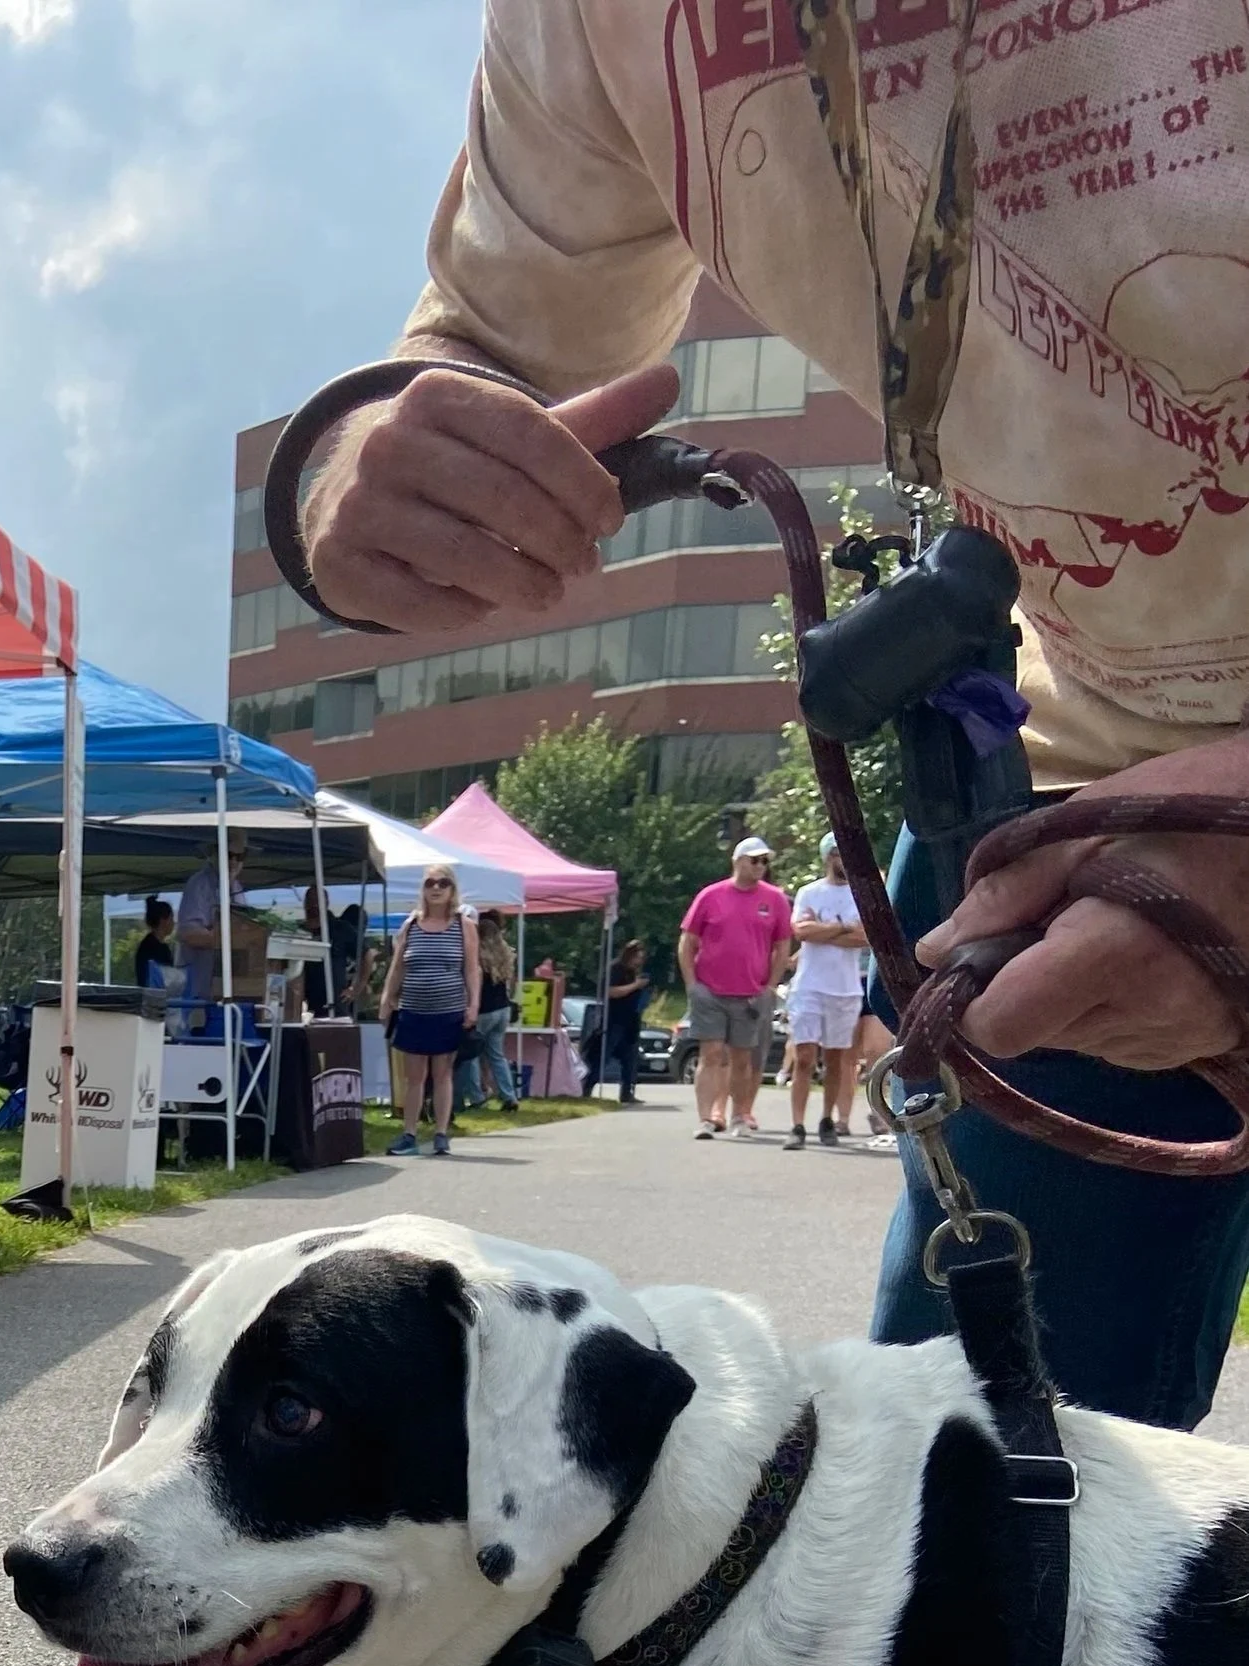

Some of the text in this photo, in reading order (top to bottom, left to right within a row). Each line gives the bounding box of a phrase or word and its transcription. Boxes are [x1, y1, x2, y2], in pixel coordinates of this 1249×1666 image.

[1190, 44, 1248, 84] THE
[972, 96, 1211, 191] UPERSHOW OF
[993, 184, 1048, 221] THE
[1068, 156, 1137, 199] YEAR
[78, 1090, 111, 1108] WD
